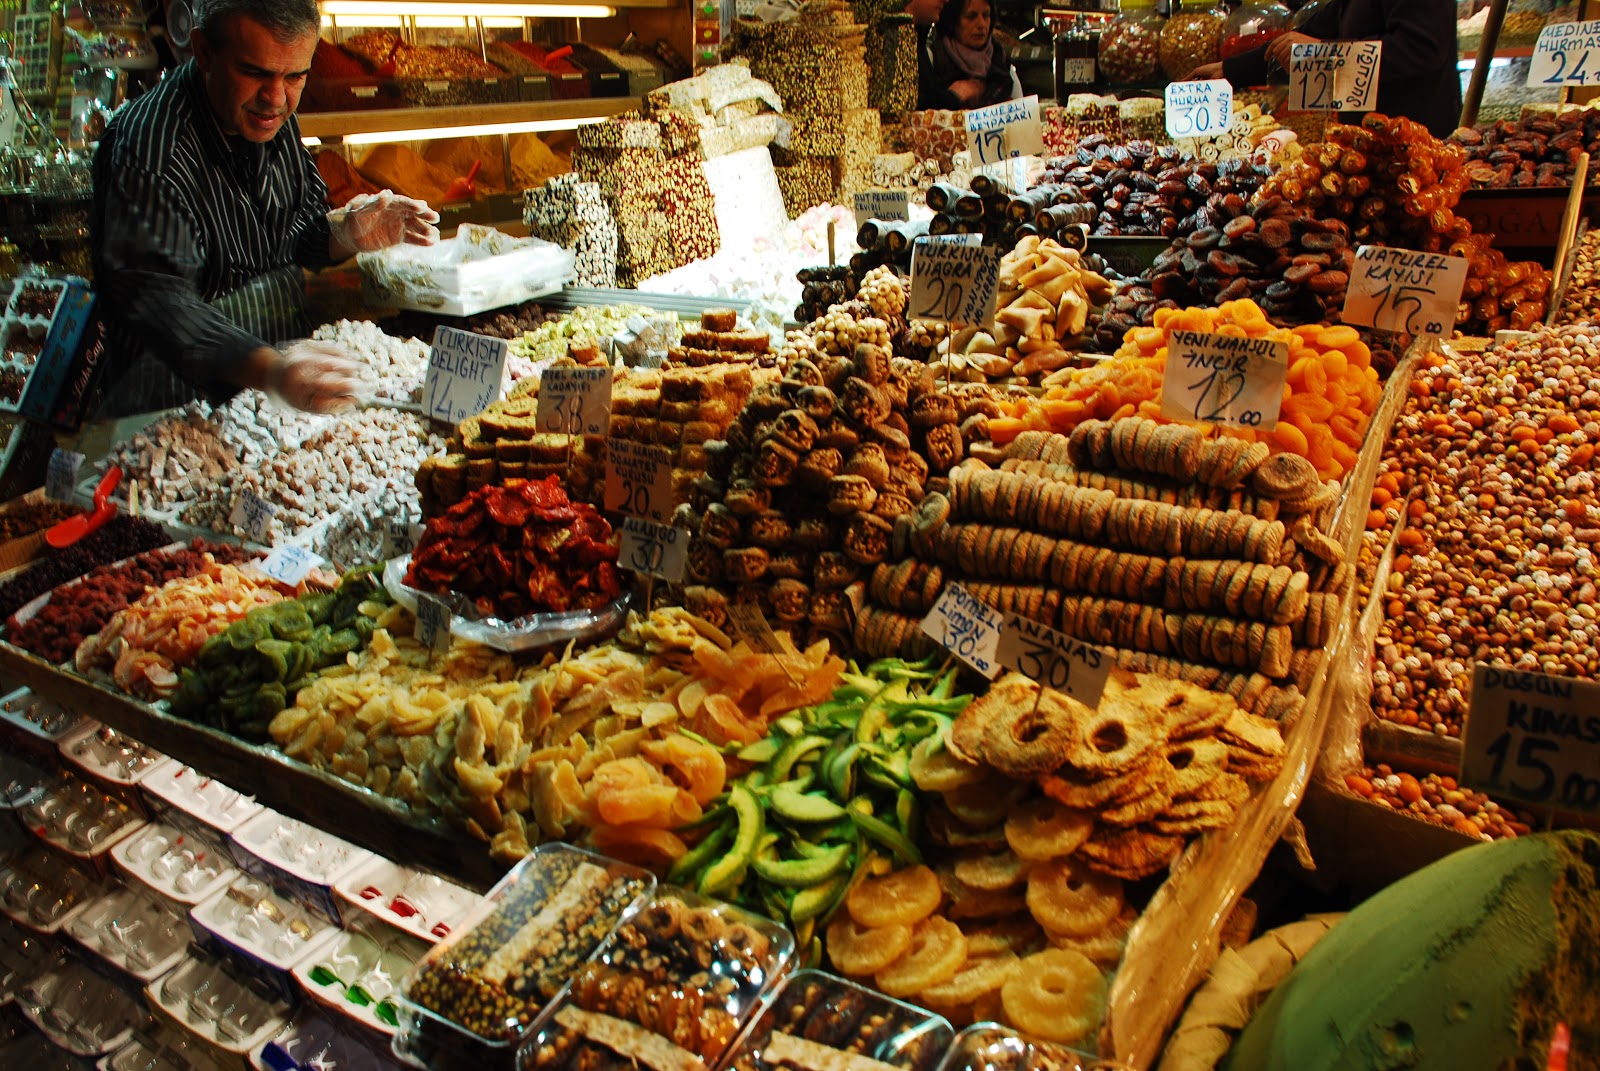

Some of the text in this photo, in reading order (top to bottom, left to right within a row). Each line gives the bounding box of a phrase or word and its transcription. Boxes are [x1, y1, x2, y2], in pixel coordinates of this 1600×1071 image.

[1293, 59, 1346, 73] ANTEP
[1171, 83, 1212, 94] EXTRA
[915, 244, 985, 262] TURKISH
[1359, 249, 1449, 271] NATUREL
[1365, 265, 1434, 285] KAYISI
[437, 327, 501, 364] TURKISH
[430, 347, 493, 385] DELIGHT
[624, 519, 677, 545] MANGO
[1008, 615, 1102, 669] ANANAS
